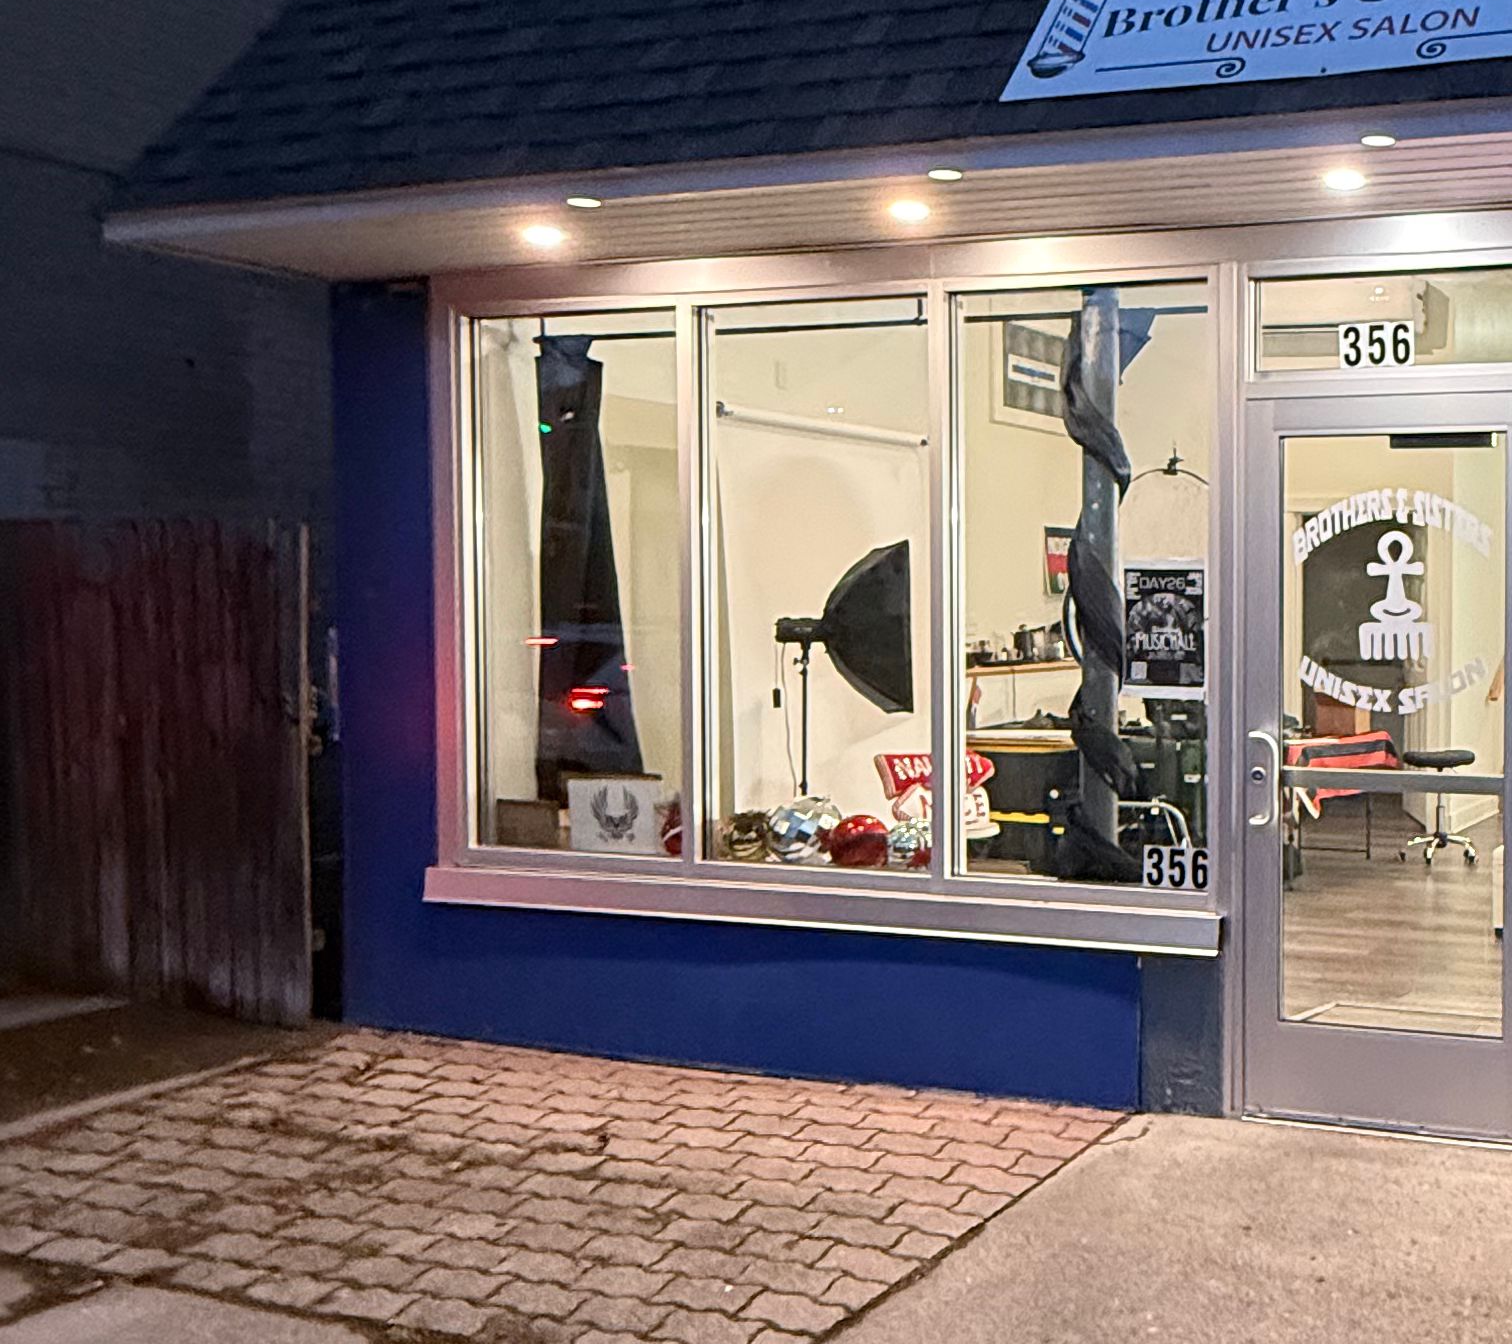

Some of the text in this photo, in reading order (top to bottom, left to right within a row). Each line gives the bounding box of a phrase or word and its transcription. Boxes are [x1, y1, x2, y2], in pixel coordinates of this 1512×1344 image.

[1206, 6, 1481, 53] UNISEX SALON
[1343, 323, 1411, 367] 356
[1292, 488, 1394, 567] BROTHERS
[1299, 656, 1487, 716] UNISEX SAON
[1146, 847, 1208, 889] 356
